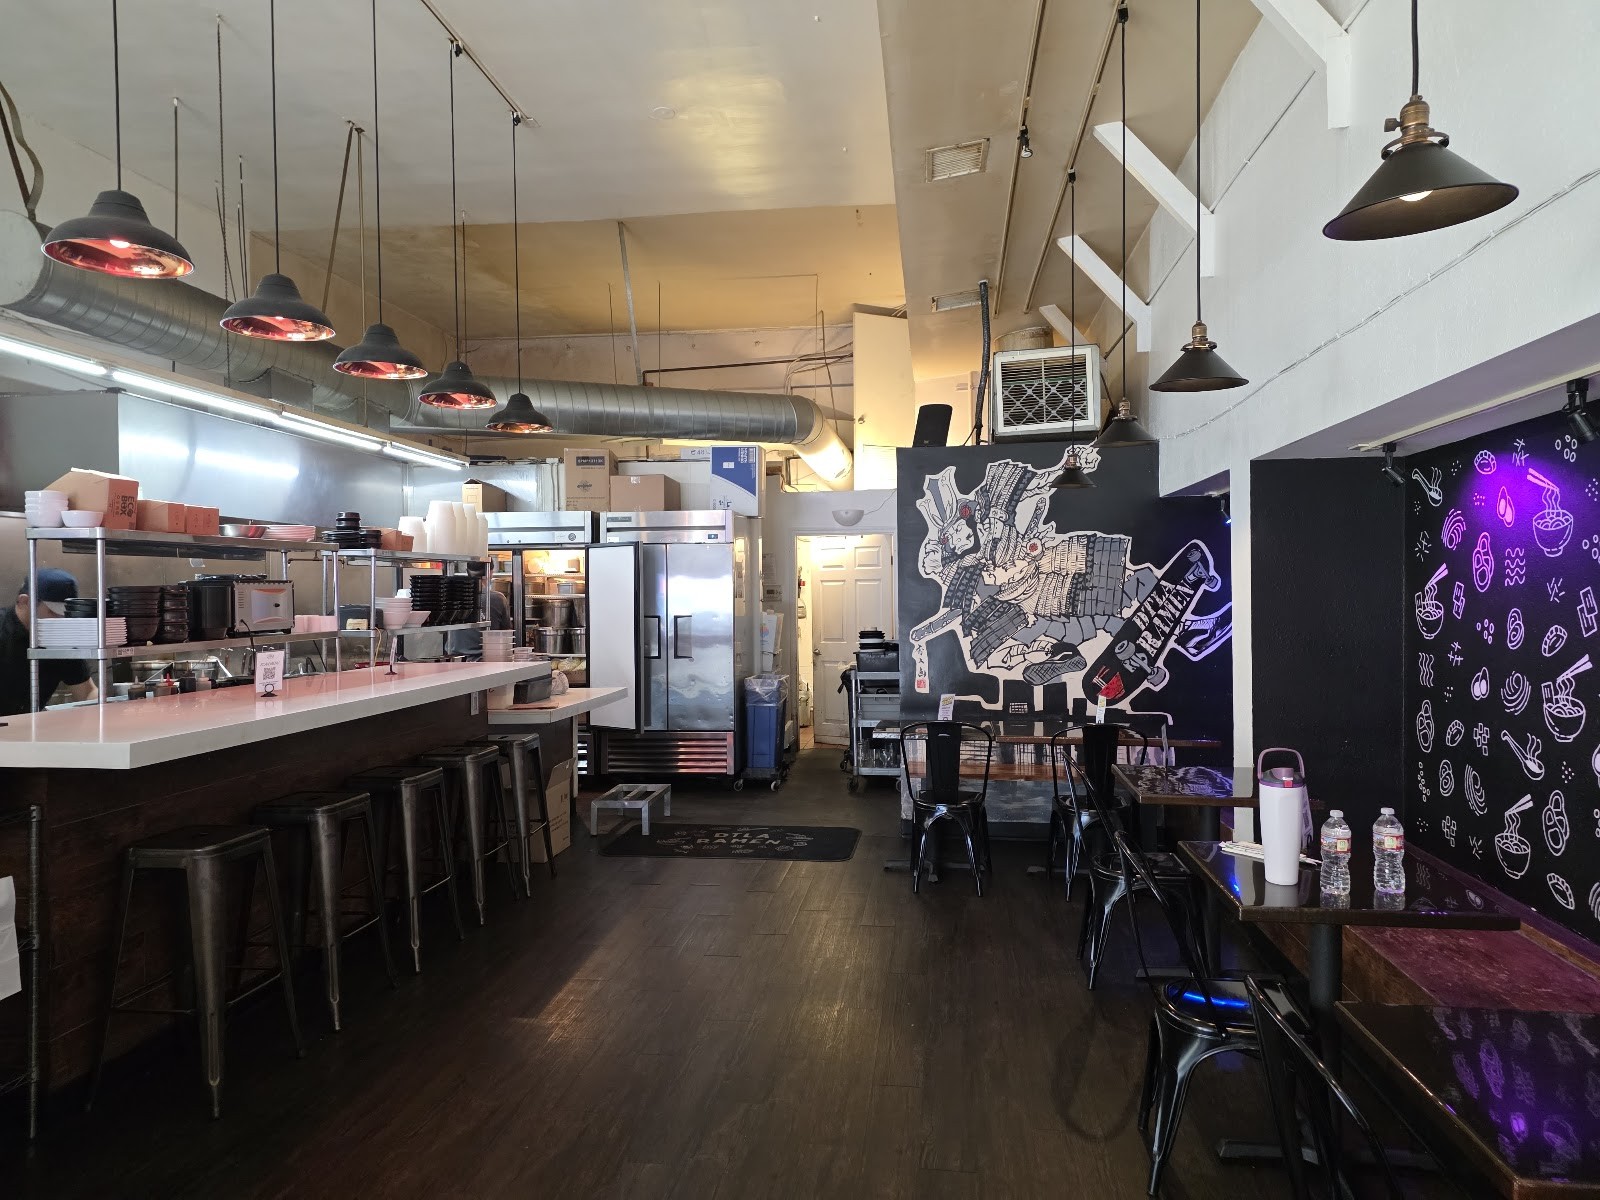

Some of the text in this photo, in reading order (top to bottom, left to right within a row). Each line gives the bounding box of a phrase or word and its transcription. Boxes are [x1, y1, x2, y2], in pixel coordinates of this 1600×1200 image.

[120, 495, 128, 516] BOX
[127, 496, 135, 518] ECO
[1132, 580, 1176, 631] DTLA
[1136, 580, 1195, 657] RAMEN
